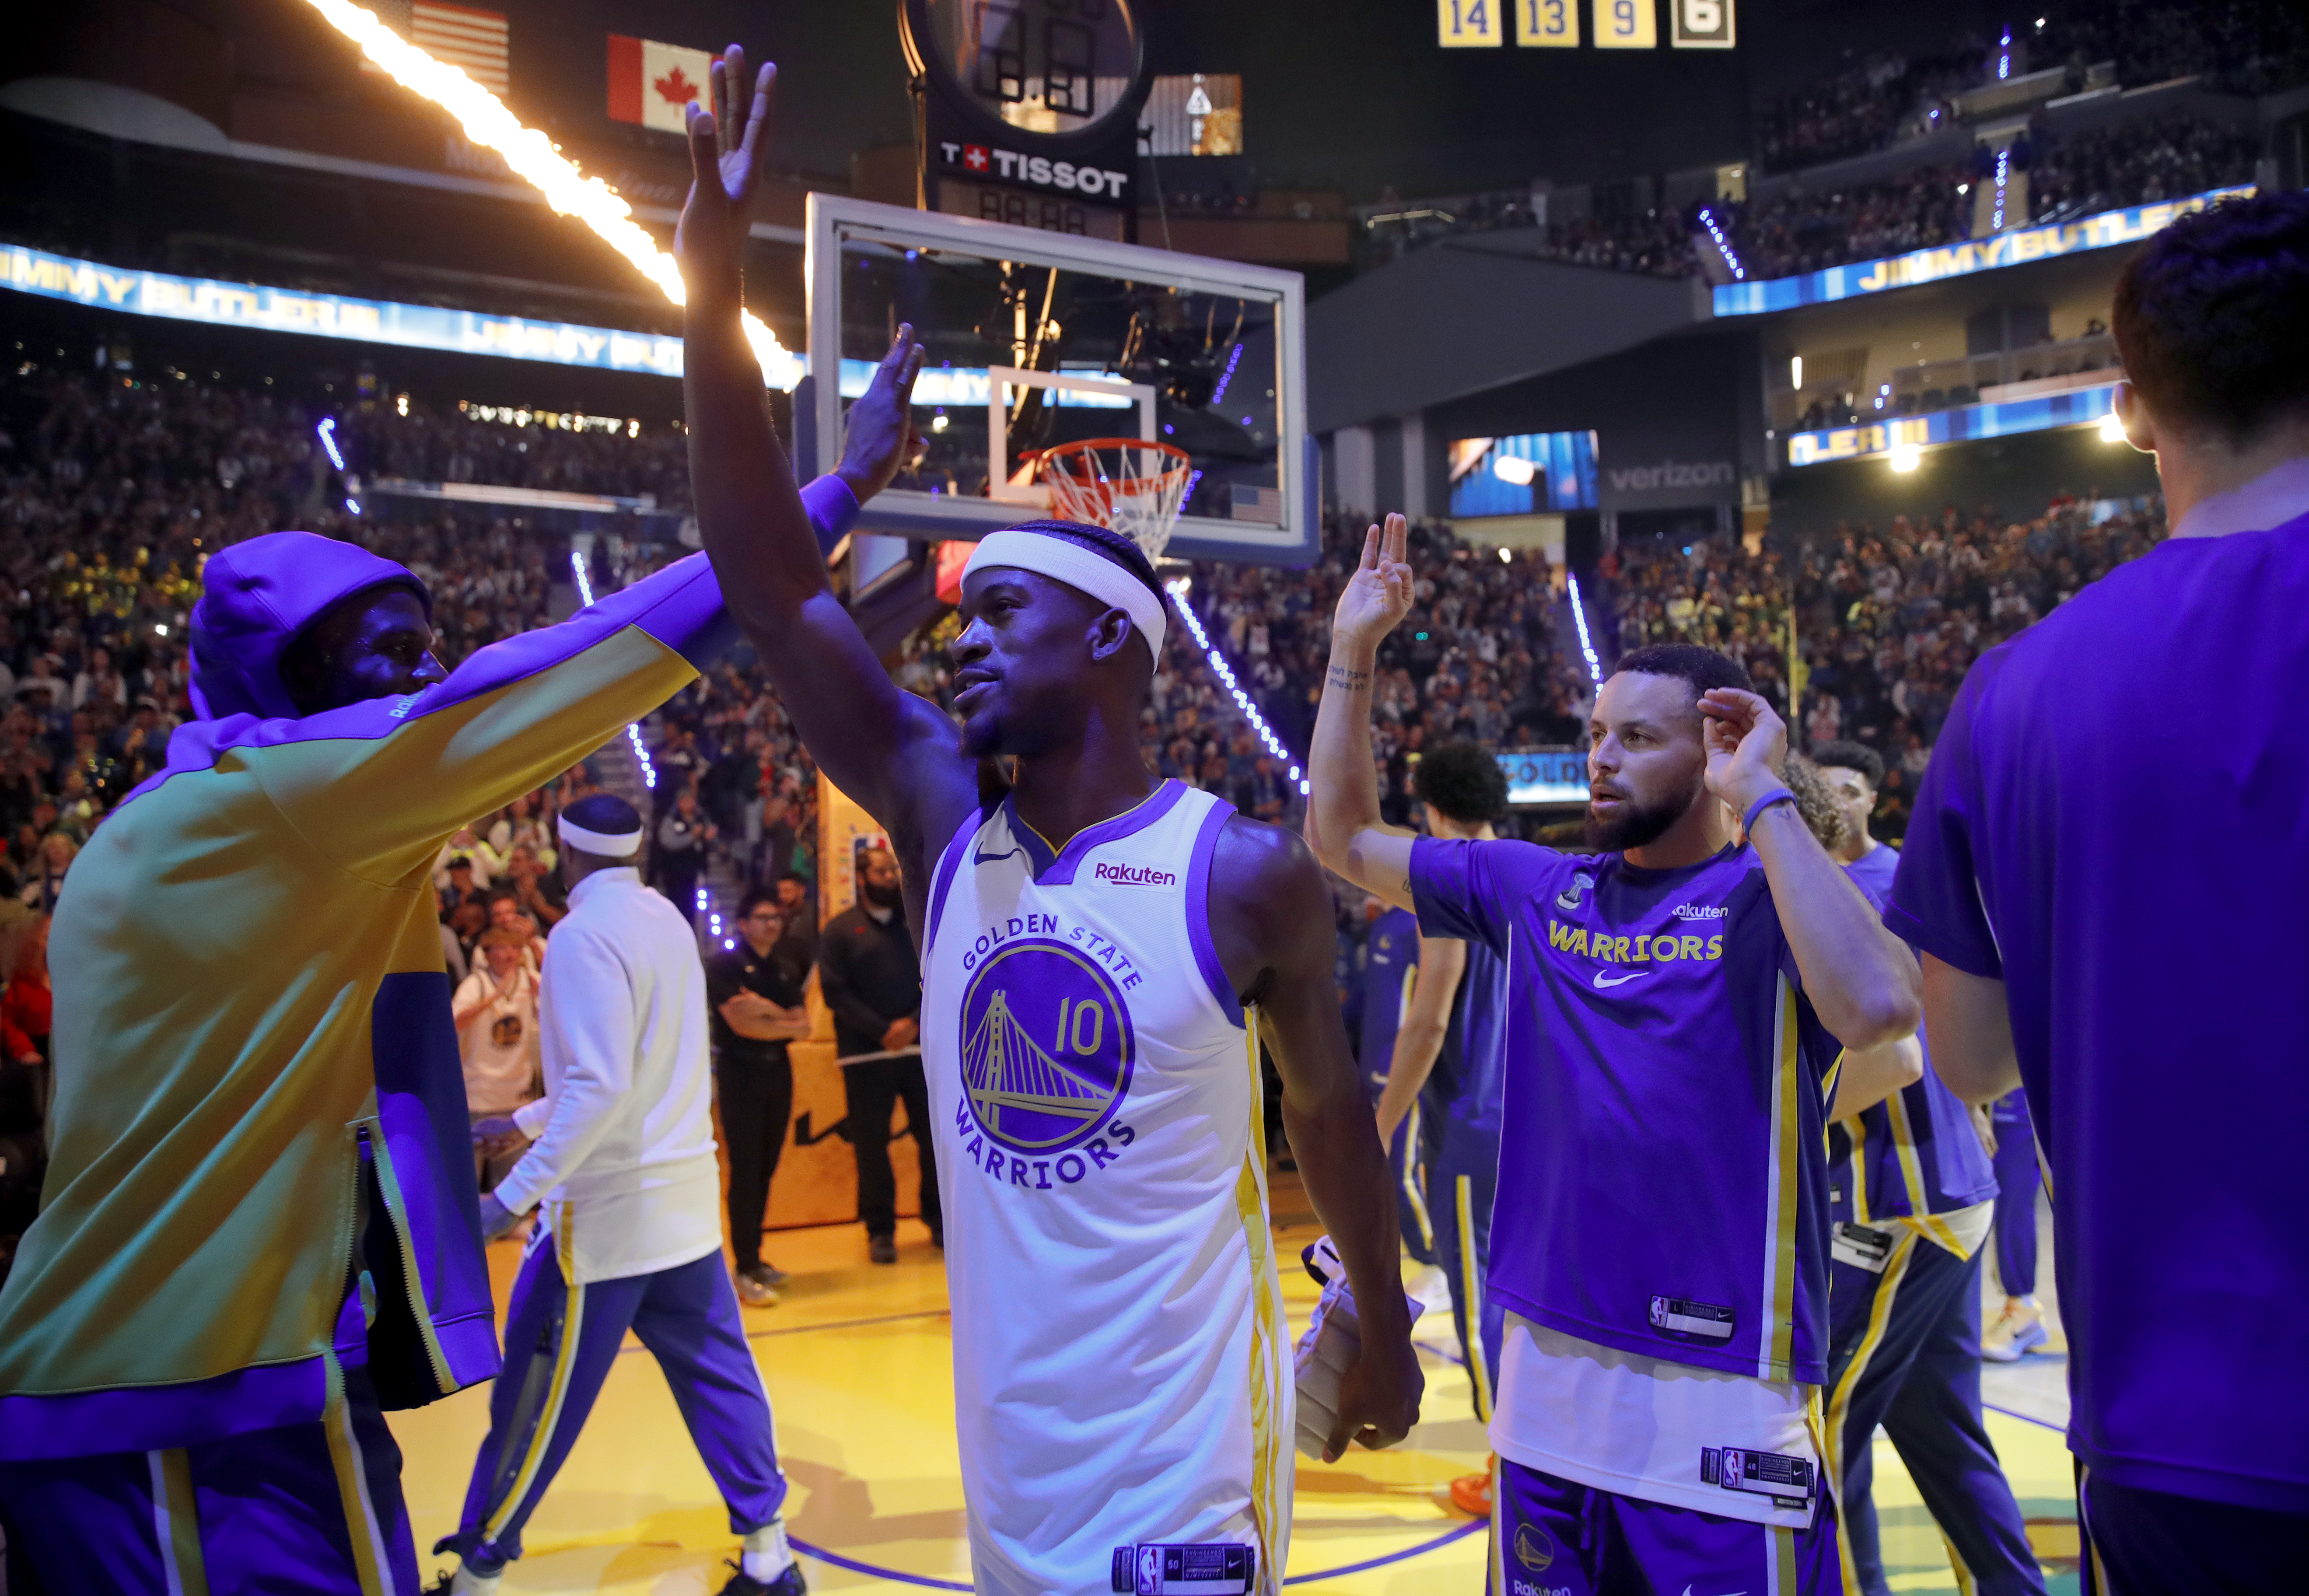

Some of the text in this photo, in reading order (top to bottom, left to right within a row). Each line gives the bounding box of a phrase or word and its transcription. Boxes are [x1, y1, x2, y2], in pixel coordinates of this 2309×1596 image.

[1451, 0, 1488, 34] 14
[1529, 0, 1566, 35] 13
[1615, 0, 1636, 35] 9
[992, 148, 1128, 199] TISSOT
[1858, 238, 2005, 290] JIMMY
[141, 276, 337, 333] BUTLER
[339, 303, 380, 334] III
[464, 320, 608, 360] JIMMY
[1788, 417, 1929, 462] TLER III
[1609, 459, 1735, 491] verizon
[1095, 862, 1175, 886] Rakuten
[1670, 902, 1729, 918] akuten
[964, 913, 1143, 991] GOLDEN STATE
[1549, 919, 1724, 963] WARRIORS
[1055, 997, 1104, 1056] 10
[955, 1095, 1136, 1190] WARRIORS
[1747, 1462, 1756, 1471] 48
[1513, 1579, 1572, 1596] Rakuten
